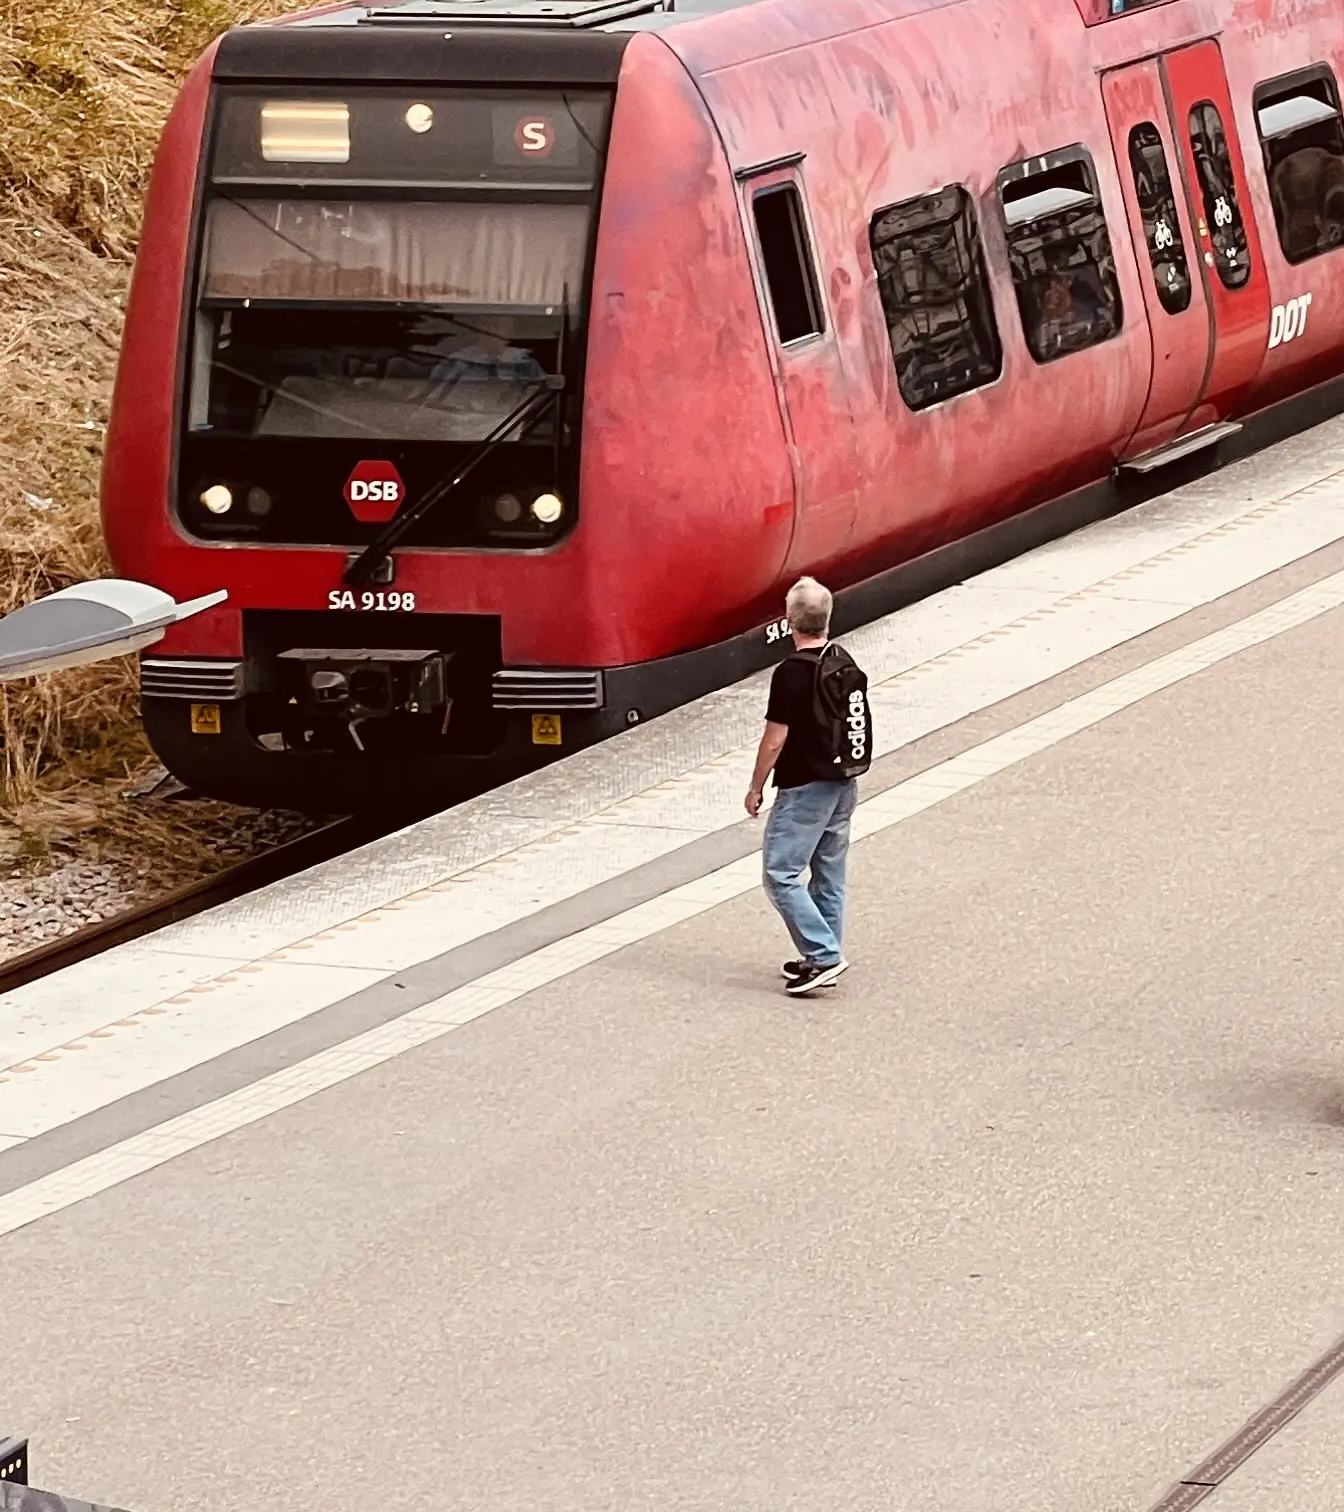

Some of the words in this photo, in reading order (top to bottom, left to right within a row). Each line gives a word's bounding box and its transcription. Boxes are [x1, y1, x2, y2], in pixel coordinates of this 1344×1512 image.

[522, 122, 546, 150] S
[1267, 292, 1312, 349] DOT
[350, 480, 399, 501] DSB
[328, 590, 356, 610] SA
[361, 591, 415, 612] 9198
[846, 690, 866, 760] adidas
